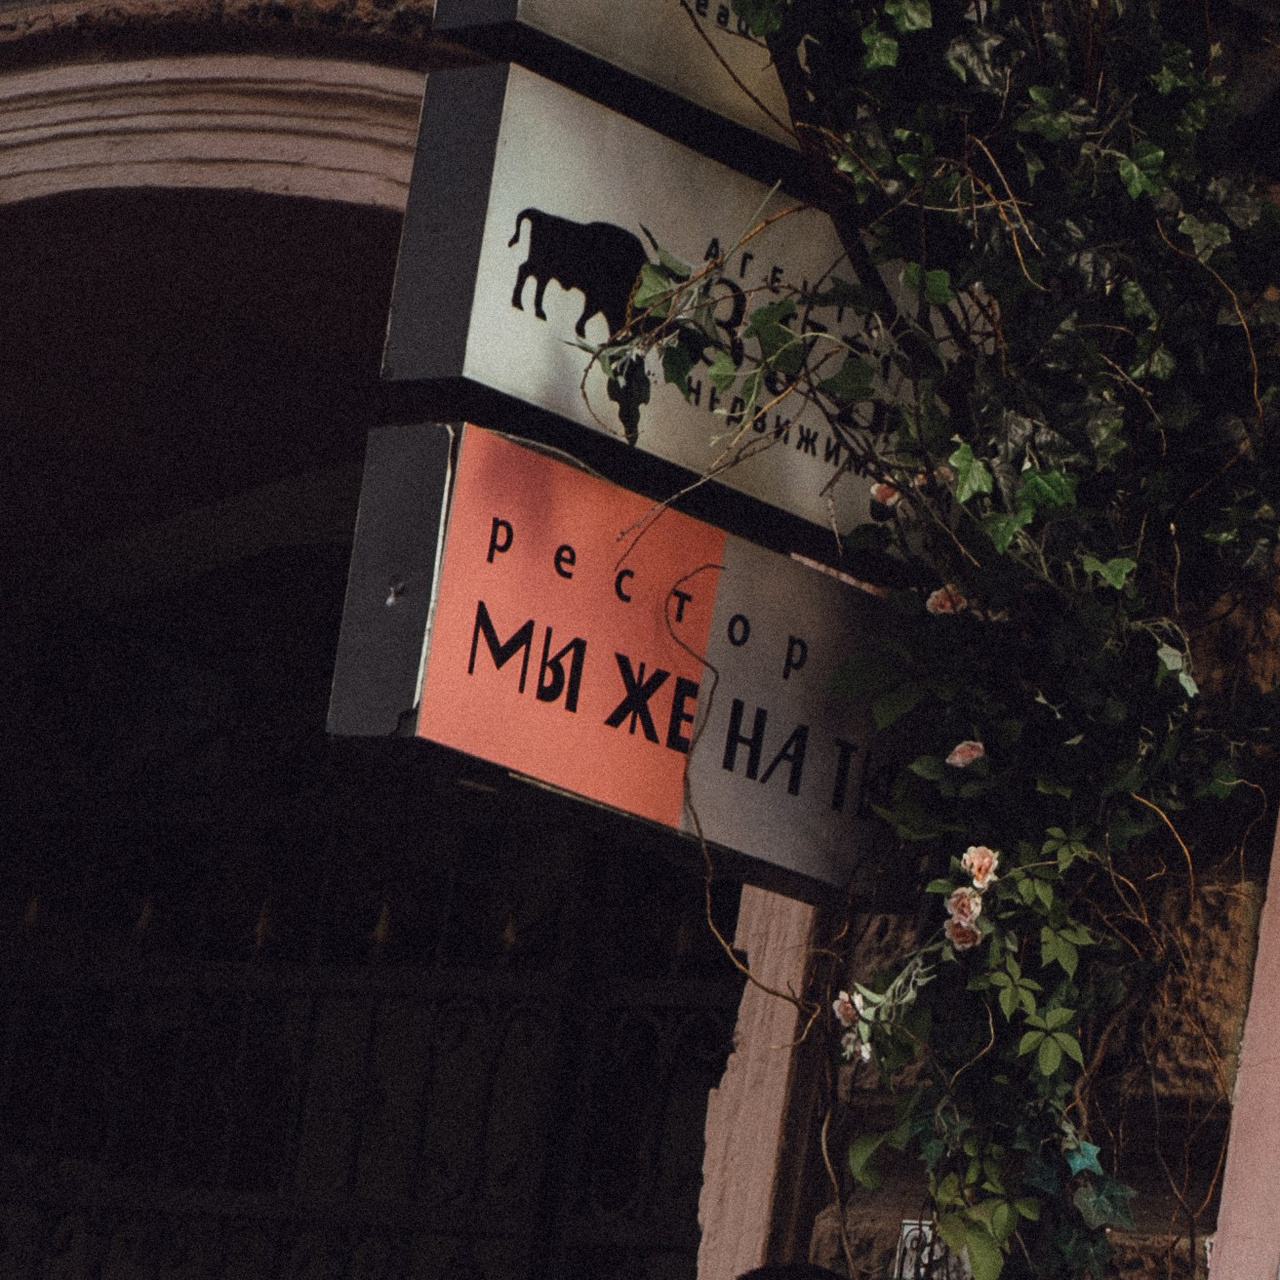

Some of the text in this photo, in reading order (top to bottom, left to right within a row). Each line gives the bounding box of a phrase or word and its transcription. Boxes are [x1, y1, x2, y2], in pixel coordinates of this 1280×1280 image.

[487, 516, 809, 681] рестор
[467, 600, 588, 714] МЫ
[604, 652, 700, 754] ЖЕ
[722, 697, 809, 796] НА
